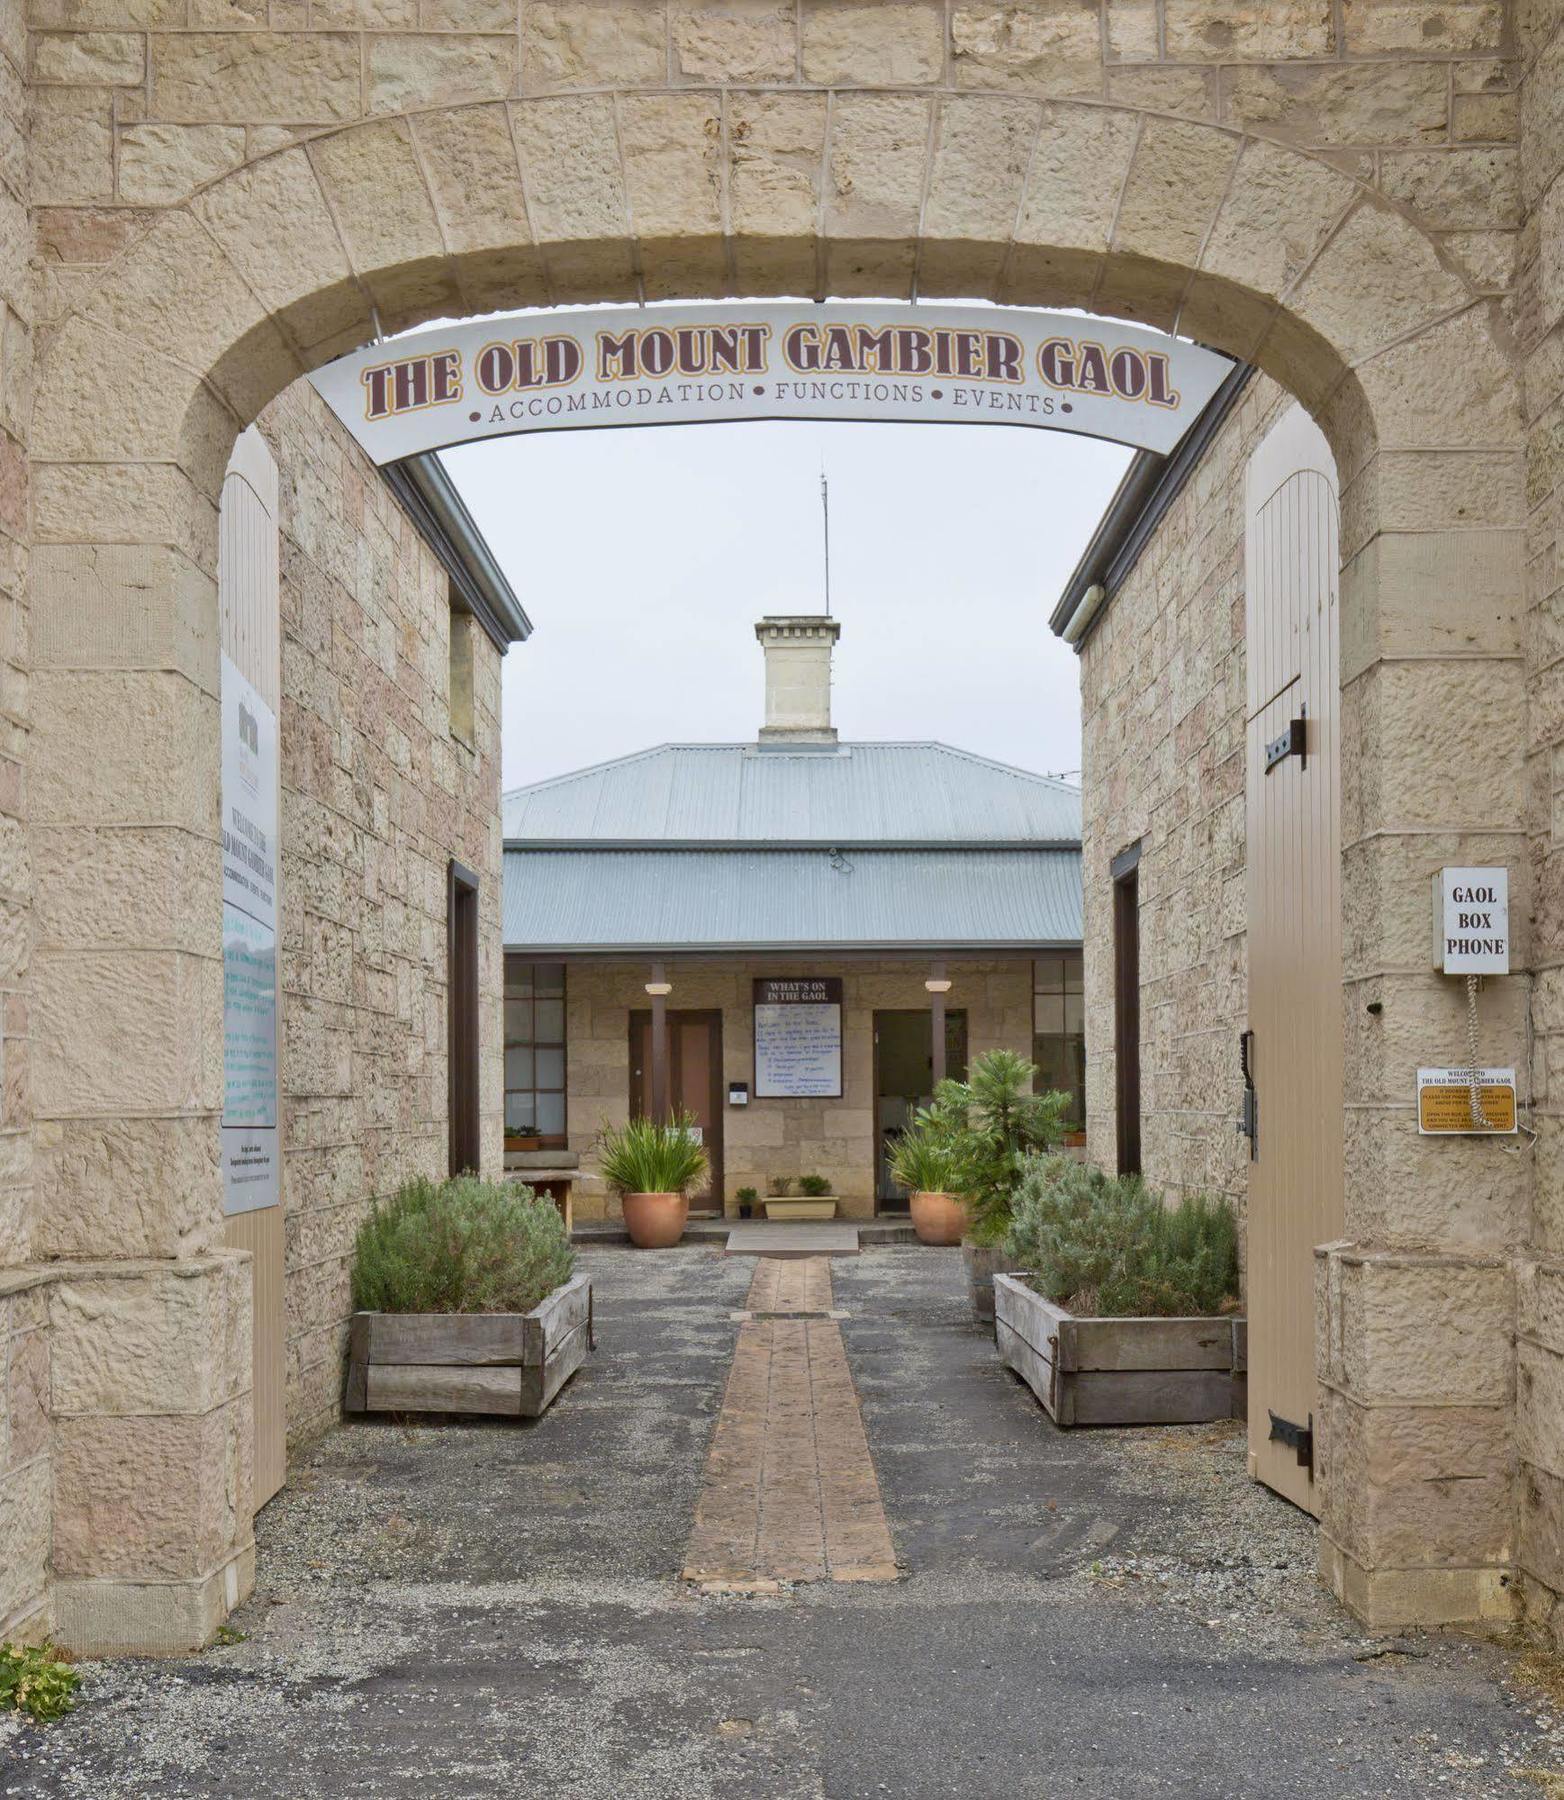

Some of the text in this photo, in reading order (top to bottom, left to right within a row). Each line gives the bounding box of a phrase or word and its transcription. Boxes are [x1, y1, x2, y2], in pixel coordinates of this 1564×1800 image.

[362, 322, 1181, 421] THE OLD MOUNT GAMBIER GAOL
[488, 383, 1055, 423] ACCOMMODATION FUNCTIONS EVENTS
[1452, 887, 1497, 903] GAOL
[1459, 913, 1491, 929] BOX
[1447, 938, 1504, 955] PHONE
[769, 982, 826, 991] WHAT'S ON
[767, 991, 778, 1001] IN
[779, 991, 800, 1001] THE
